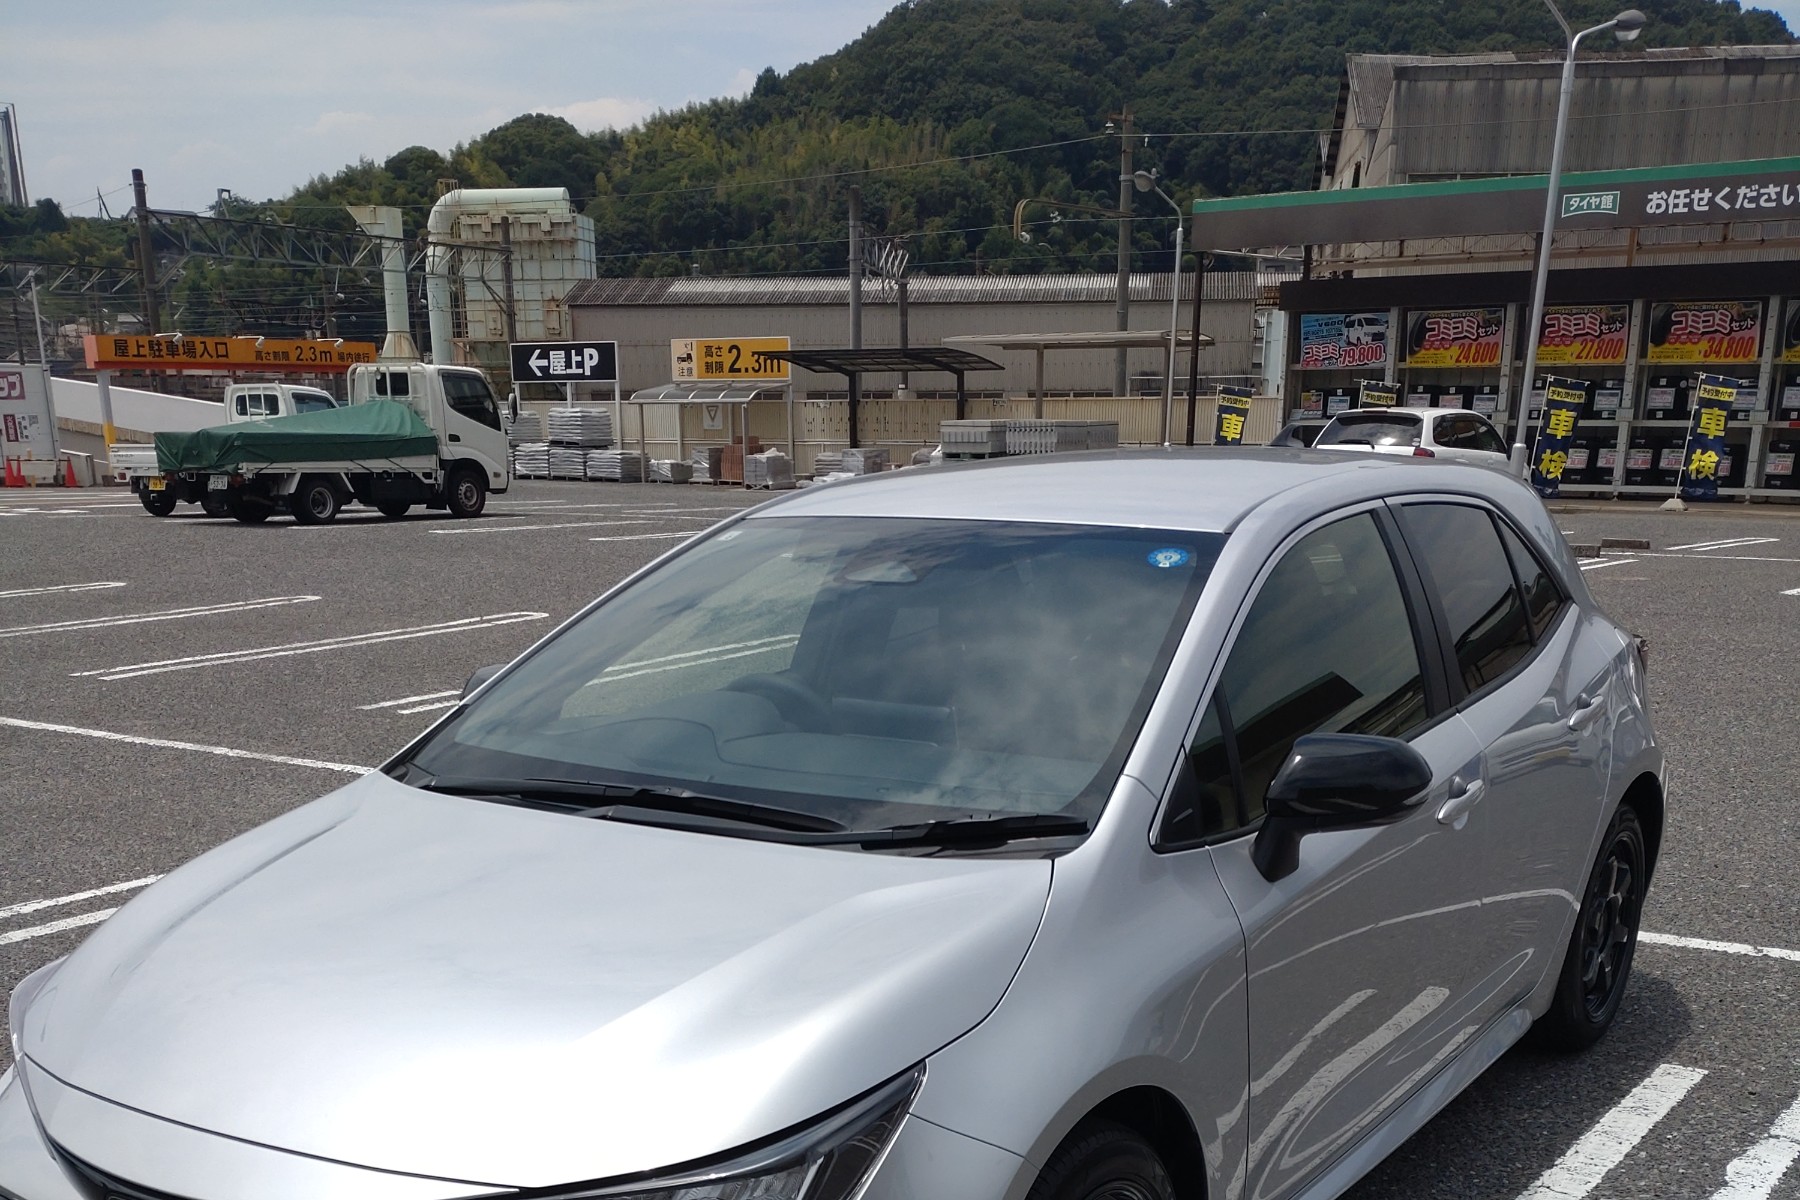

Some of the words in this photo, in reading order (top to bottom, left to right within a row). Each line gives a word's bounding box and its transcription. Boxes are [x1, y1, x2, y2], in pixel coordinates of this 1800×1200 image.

[1569, 194, 1614, 210] タイヤ館
[1646, 184, 1800, 214] お任せください
[1426, 316, 1478, 340] コミコミ
[1478, 324, 1498, 336] セット
[1545, 313, 1600, 337] コミコミ
[1601, 321, 1623, 333] セット
[1671, 309, 1731, 334] コミコミ
[1731, 318, 1755, 331] セット
[113, 339, 230, 360] 屋上駐車場入口
[255, 349, 290, 362] 高さ制限
[295, 346, 333, 363] 2.3m
[337, 351, 370, 363] 場内徐行
[704, 345, 723, 357] 高さ
[727, 344, 781, 374] 2.3m
[1303, 343, 1340, 361] コミコミ
[1339, 344, 1384, 366] 79,800
[1455, 341, 1499, 364] 24,800
[1575, 338, 1624, 361] 27,800
[1703, 336, 1755, 359] 34,800
[550, 348, 599, 376] 屋上P
[678, 366, 694, 377] 注意
[704, 361, 724, 374] 制限
[1220, 394, 1250, 407] 予約受付中
[1364, 392, 1395, 403] 予約受付中
[1550, 389, 1583, 400] 予約受付中
[1701, 387, 1734, 399] 予約受付中
[1220, 413, 1244, 441] 車
[1539, 409, 1577, 480] 車検
[1688, 408, 1727, 480] 車検
